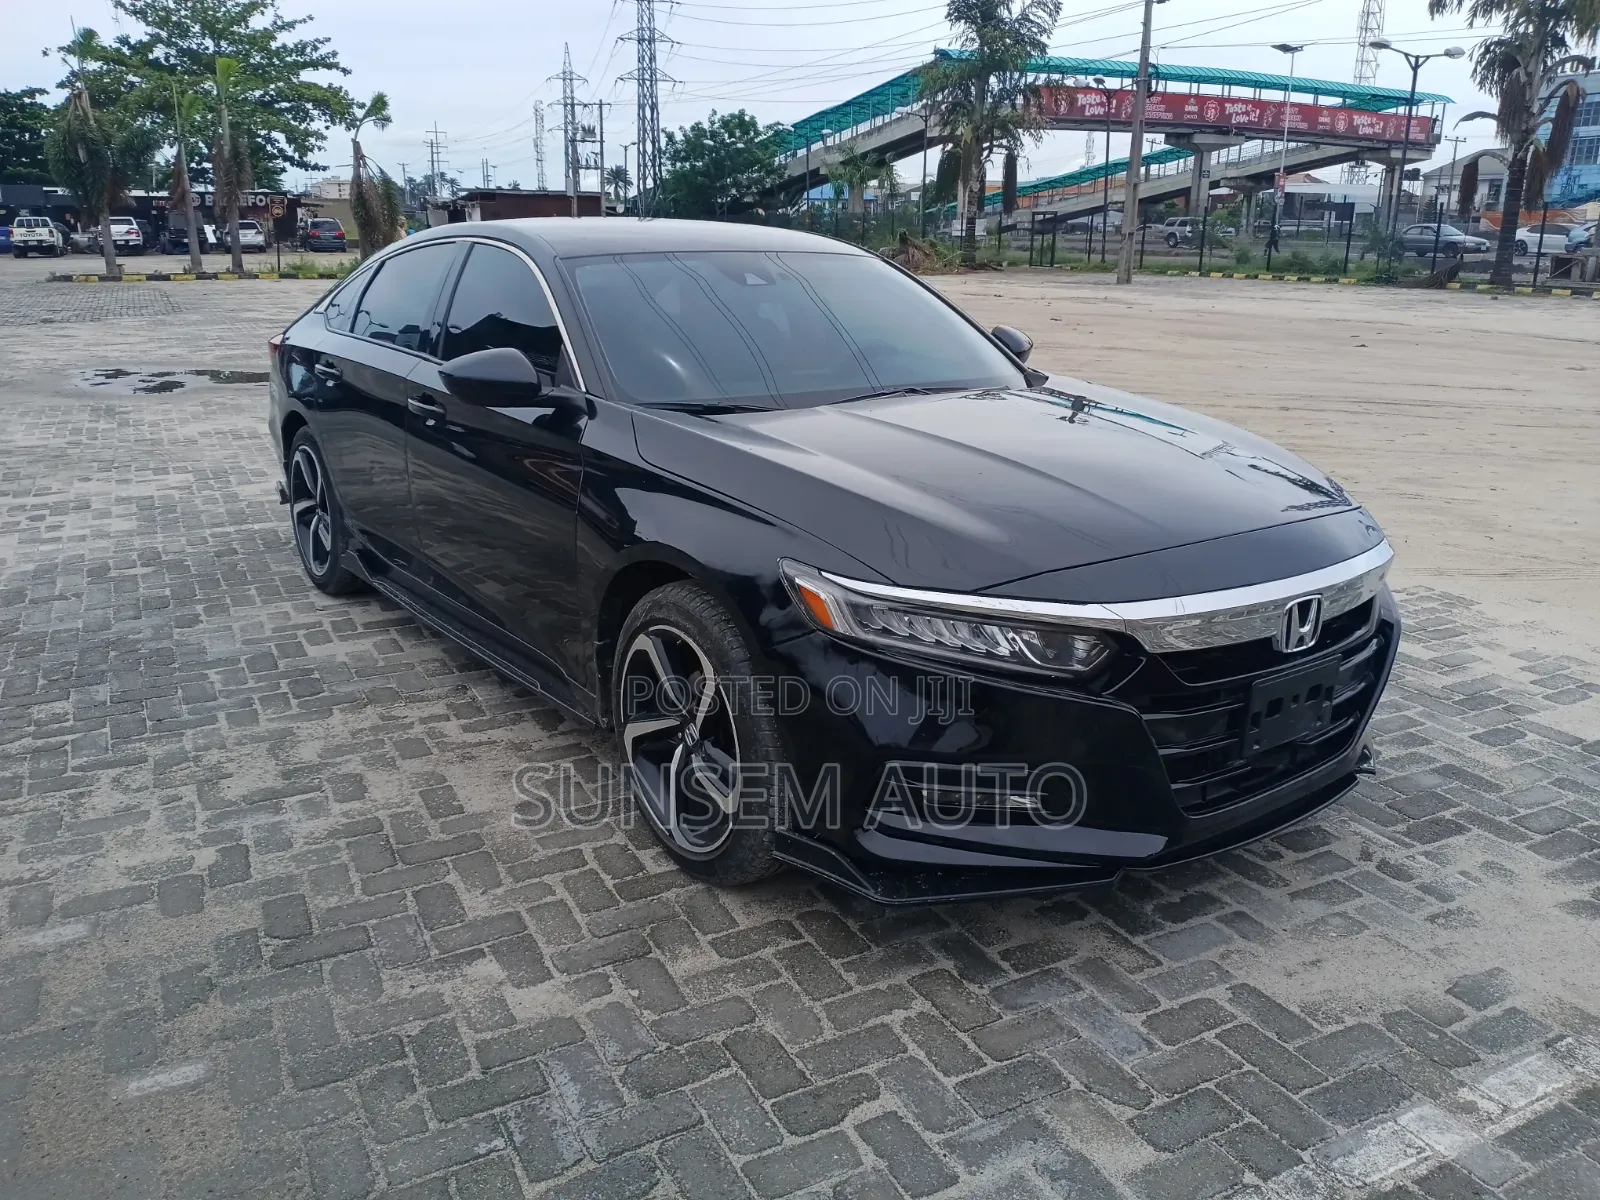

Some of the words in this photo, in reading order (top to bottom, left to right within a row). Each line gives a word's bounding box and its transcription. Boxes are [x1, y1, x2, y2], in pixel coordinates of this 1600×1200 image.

[1076, 93, 1101, 107] Taste
[1085, 105, 1105, 116] Love
[1225, 103, 1247, 115] Taste
[1232, 113, 1250, 124] Love
[1353, 115, 1372, 126] Taste
